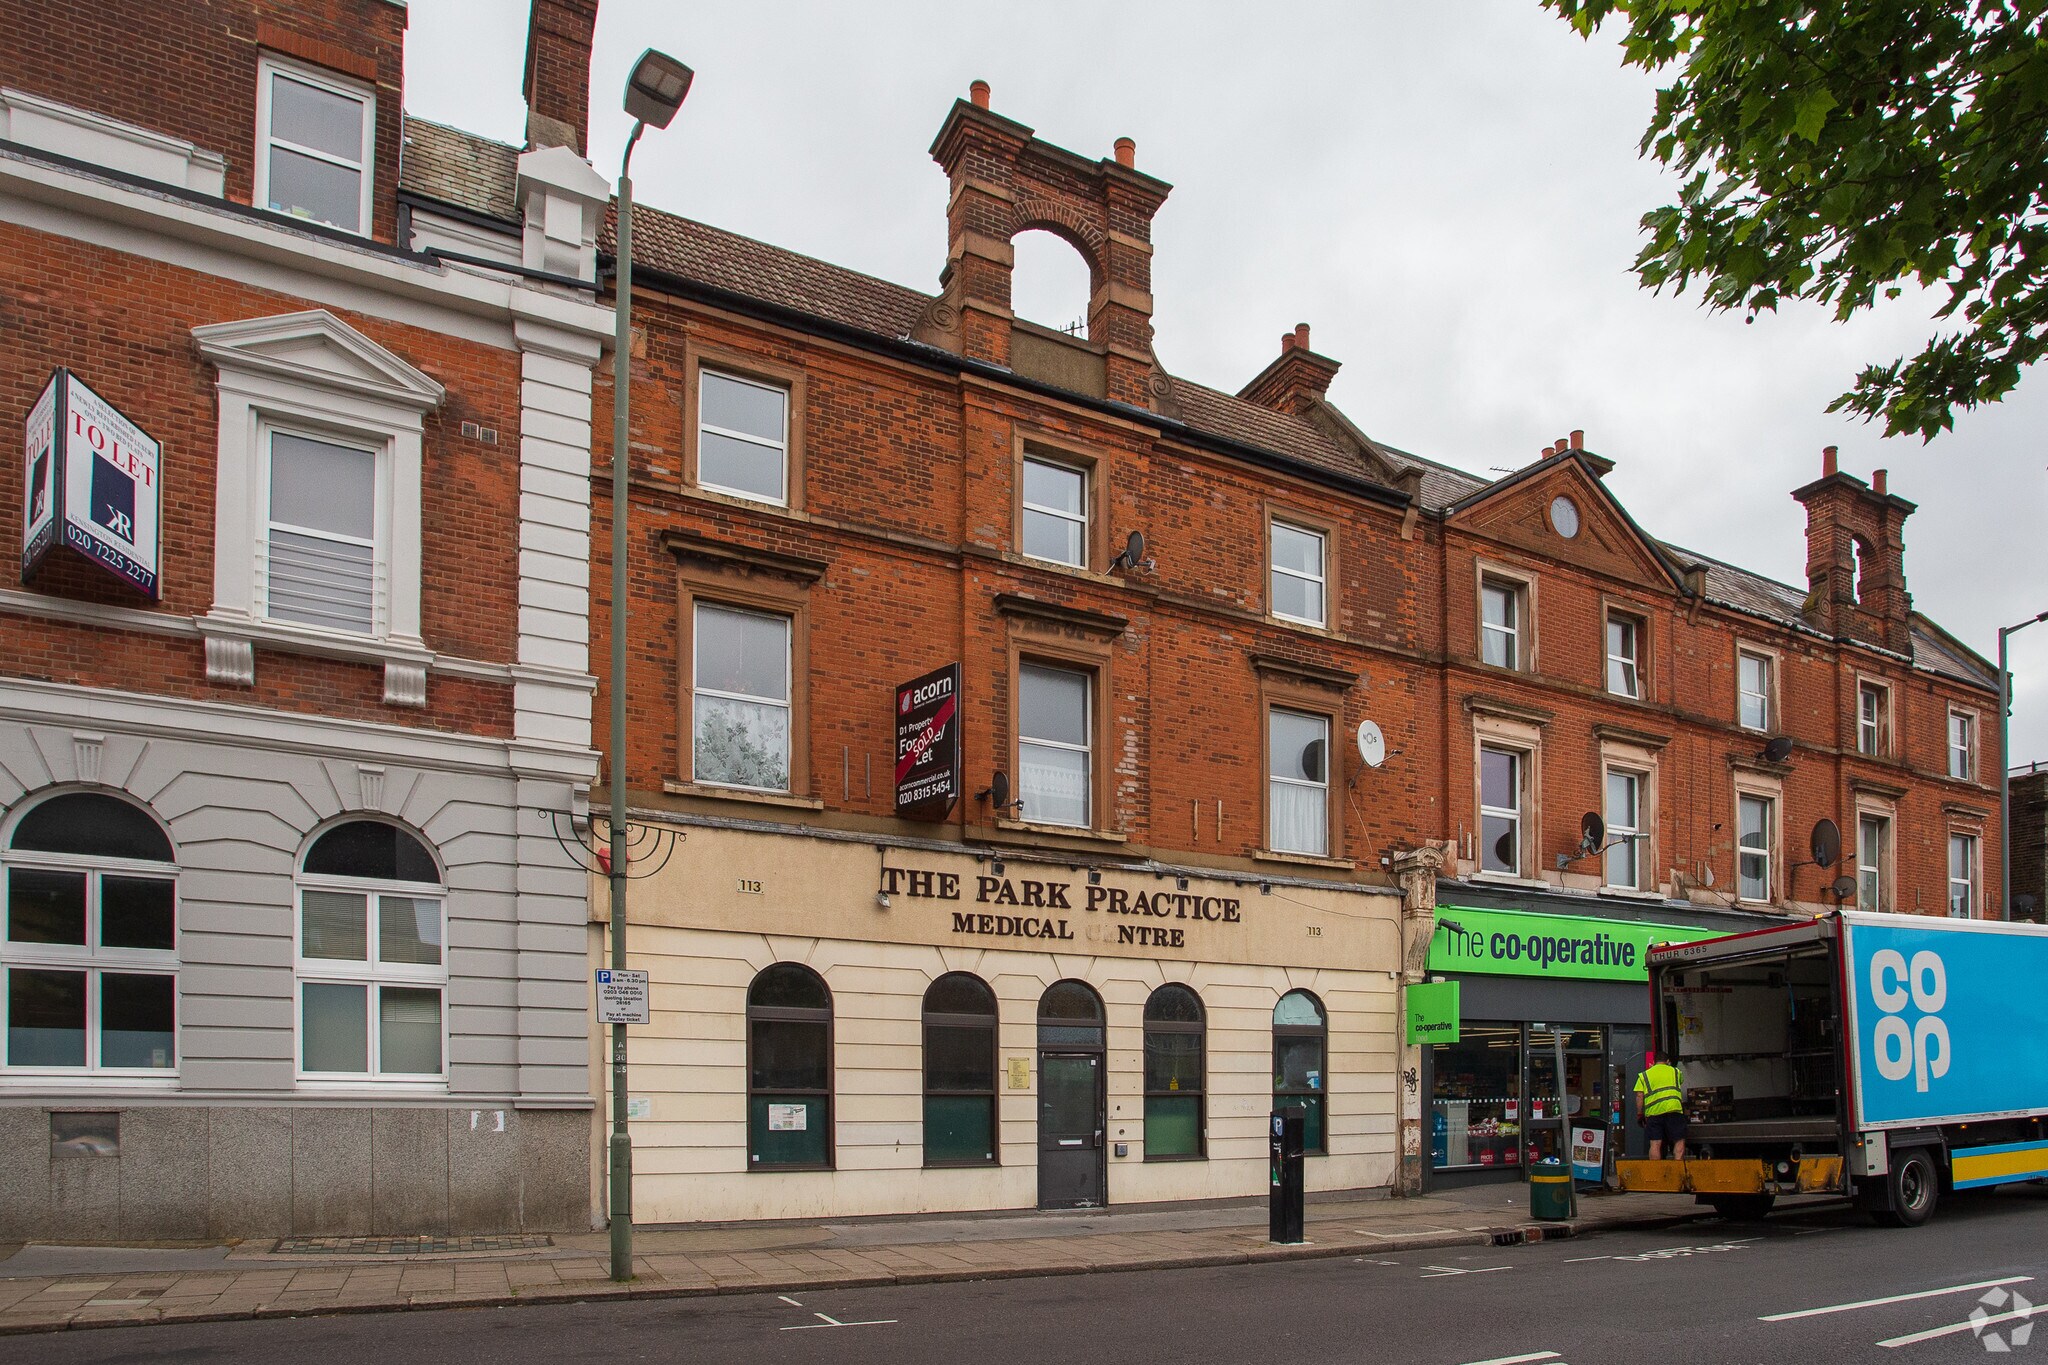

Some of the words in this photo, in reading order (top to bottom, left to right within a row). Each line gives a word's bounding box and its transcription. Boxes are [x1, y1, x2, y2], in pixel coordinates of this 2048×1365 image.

[75, 392, 95, 412] NEWLY
[96, 409, 133, 443] REFURBISHED
[134, 439, 155, 459] LUXURY
[98, 403, 129, 429] SELECTION
[71, 410, 105, 450] TO
[112, 440, 155, 488] LET
[71, 513, 113, 544] KENSINGTON
[113, 539, 151, 569] RESIDENTIAL
[68, 524, 91, 550] 020
[95, 541, 124, 569] 7225
[126, 561, 153, 588] 2277
[913, 677, 952, 704] acorn
[899, 726, 907, 736] D1
[913, 727, 934, 758] SOLD
[899, 791, 913, 805] 020
[913, 785, 931, 801] 8315
[932, 779, 951, 796] 5454
[739, 879, 762, 893] 113
[882, 867, 960, 900] THE
[976, 875, 1072, 909] PARK
[1085, 885, 1241, 923] PRACTICE
[952, 912, 1075, 940] MEDICAL
[1085, 923, 1185, 948] NTRE
[1307, 926, 1321, 936] 113
[1445, 920, 1484, 958] The
[1490, 932, 1635, 969] co-operative
[1653, 951, 1680, 961] THUR
[1684, 946, 1707, 955] 6365
[600, 972, 609, 982] P
[1414, 1013, 1425, 1023] The
[1415, 1021, 1453, 1033] co-operative
